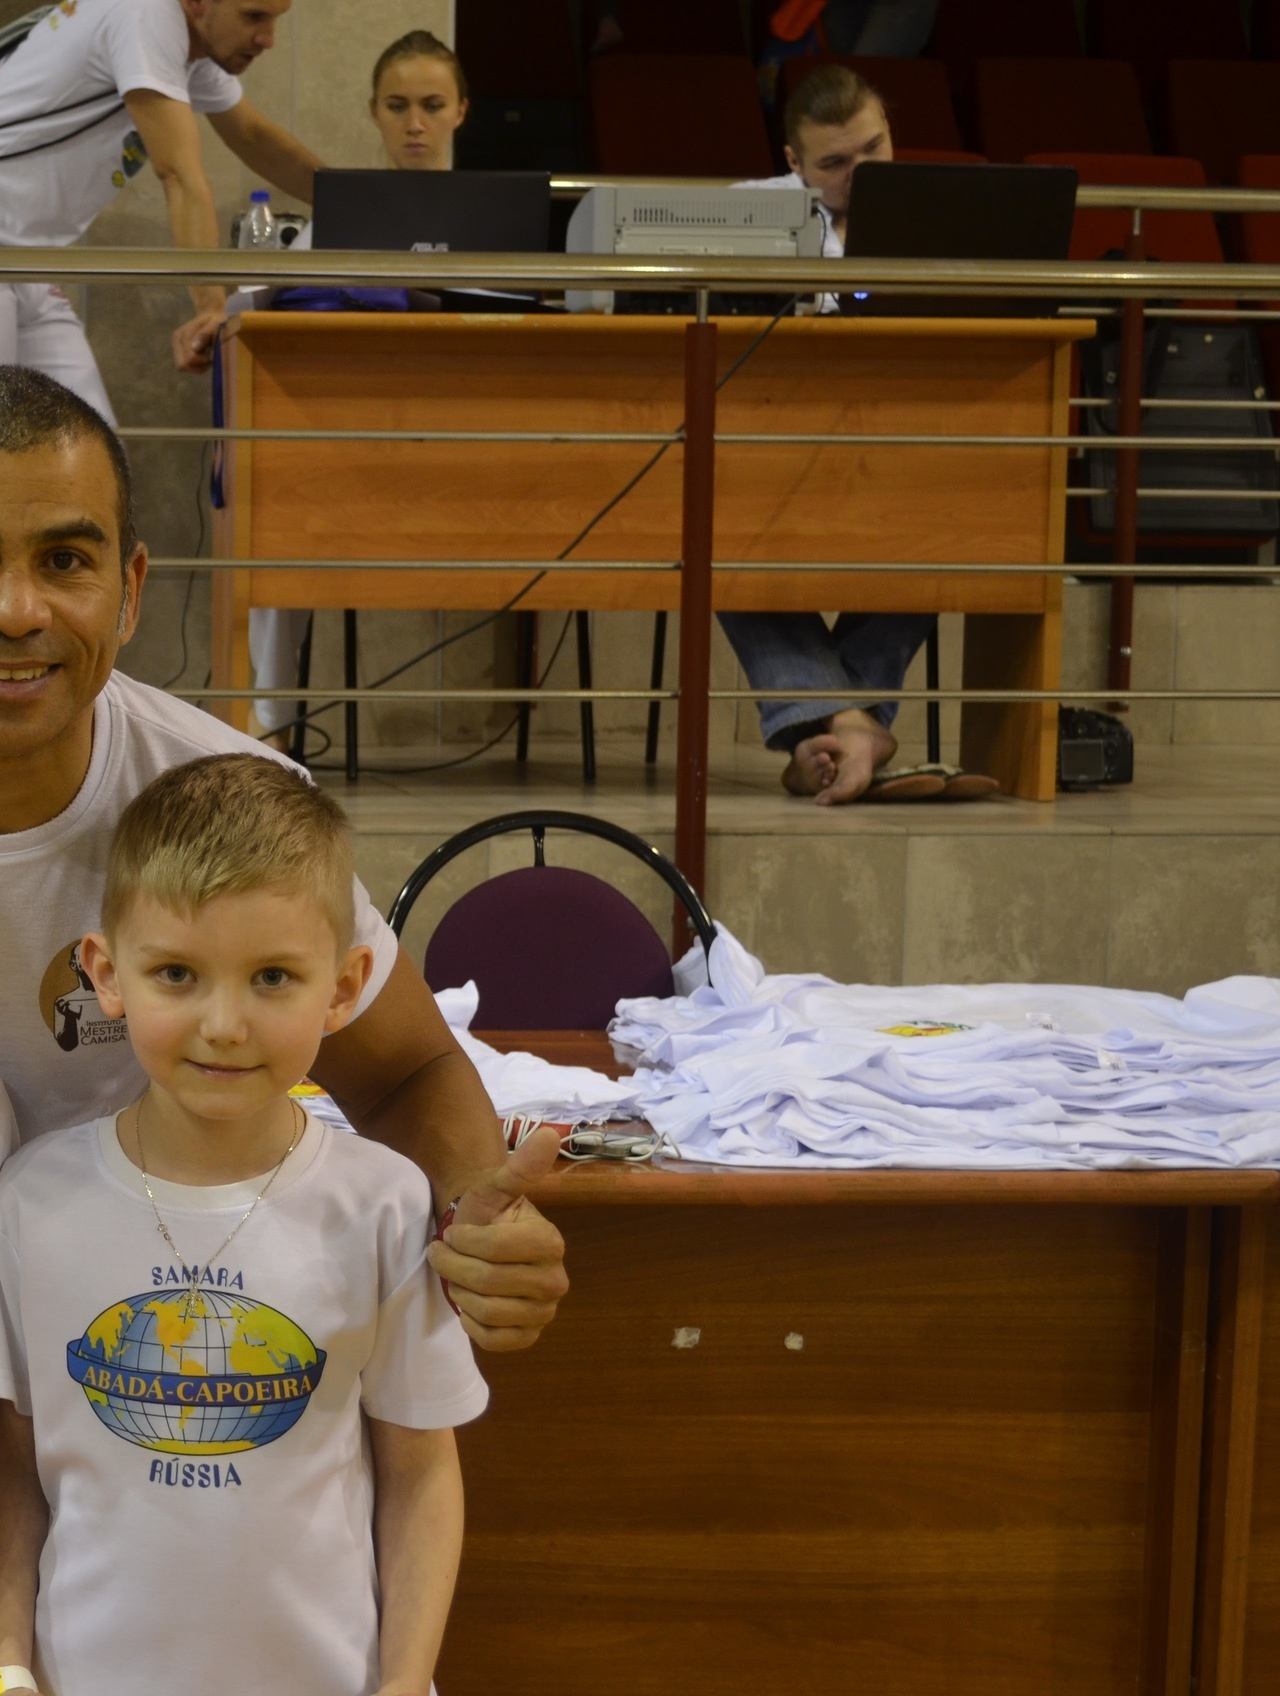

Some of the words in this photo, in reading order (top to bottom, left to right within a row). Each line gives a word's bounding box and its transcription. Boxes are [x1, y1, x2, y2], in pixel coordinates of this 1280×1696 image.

[410, 241, 449, 252] ASUS
[80, 1024, 128, 1036] MESTRE
[80, 1034, 126, 1046] CAMISA
[150, 1264, 245, 1290] SAMARA
[81, 1365, 313, 1403] ABADÁ-CAPOEIRA
[148, 1457, 242, 1489] RÚSSIA
